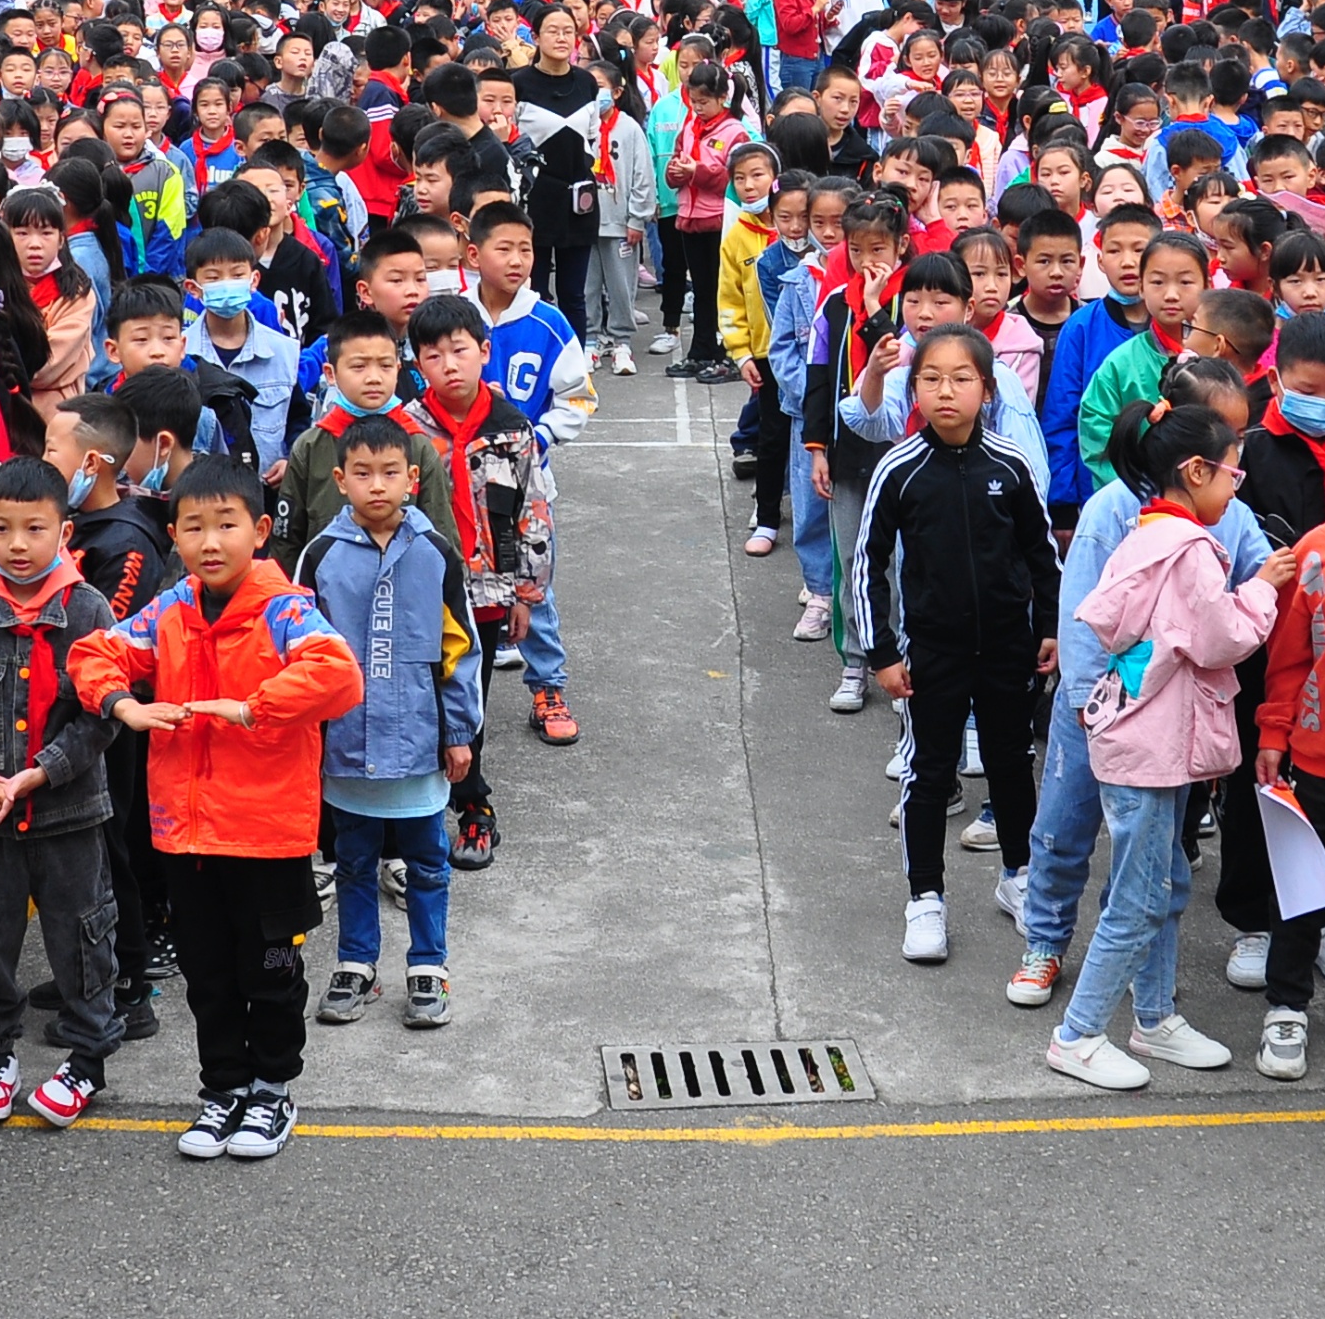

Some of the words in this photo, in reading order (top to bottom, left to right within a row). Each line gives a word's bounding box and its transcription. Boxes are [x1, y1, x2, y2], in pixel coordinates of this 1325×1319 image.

[143, 200, 157, 220] 3
[506, 351, 543, 402] G
[370, 637, 392, 679] ME
